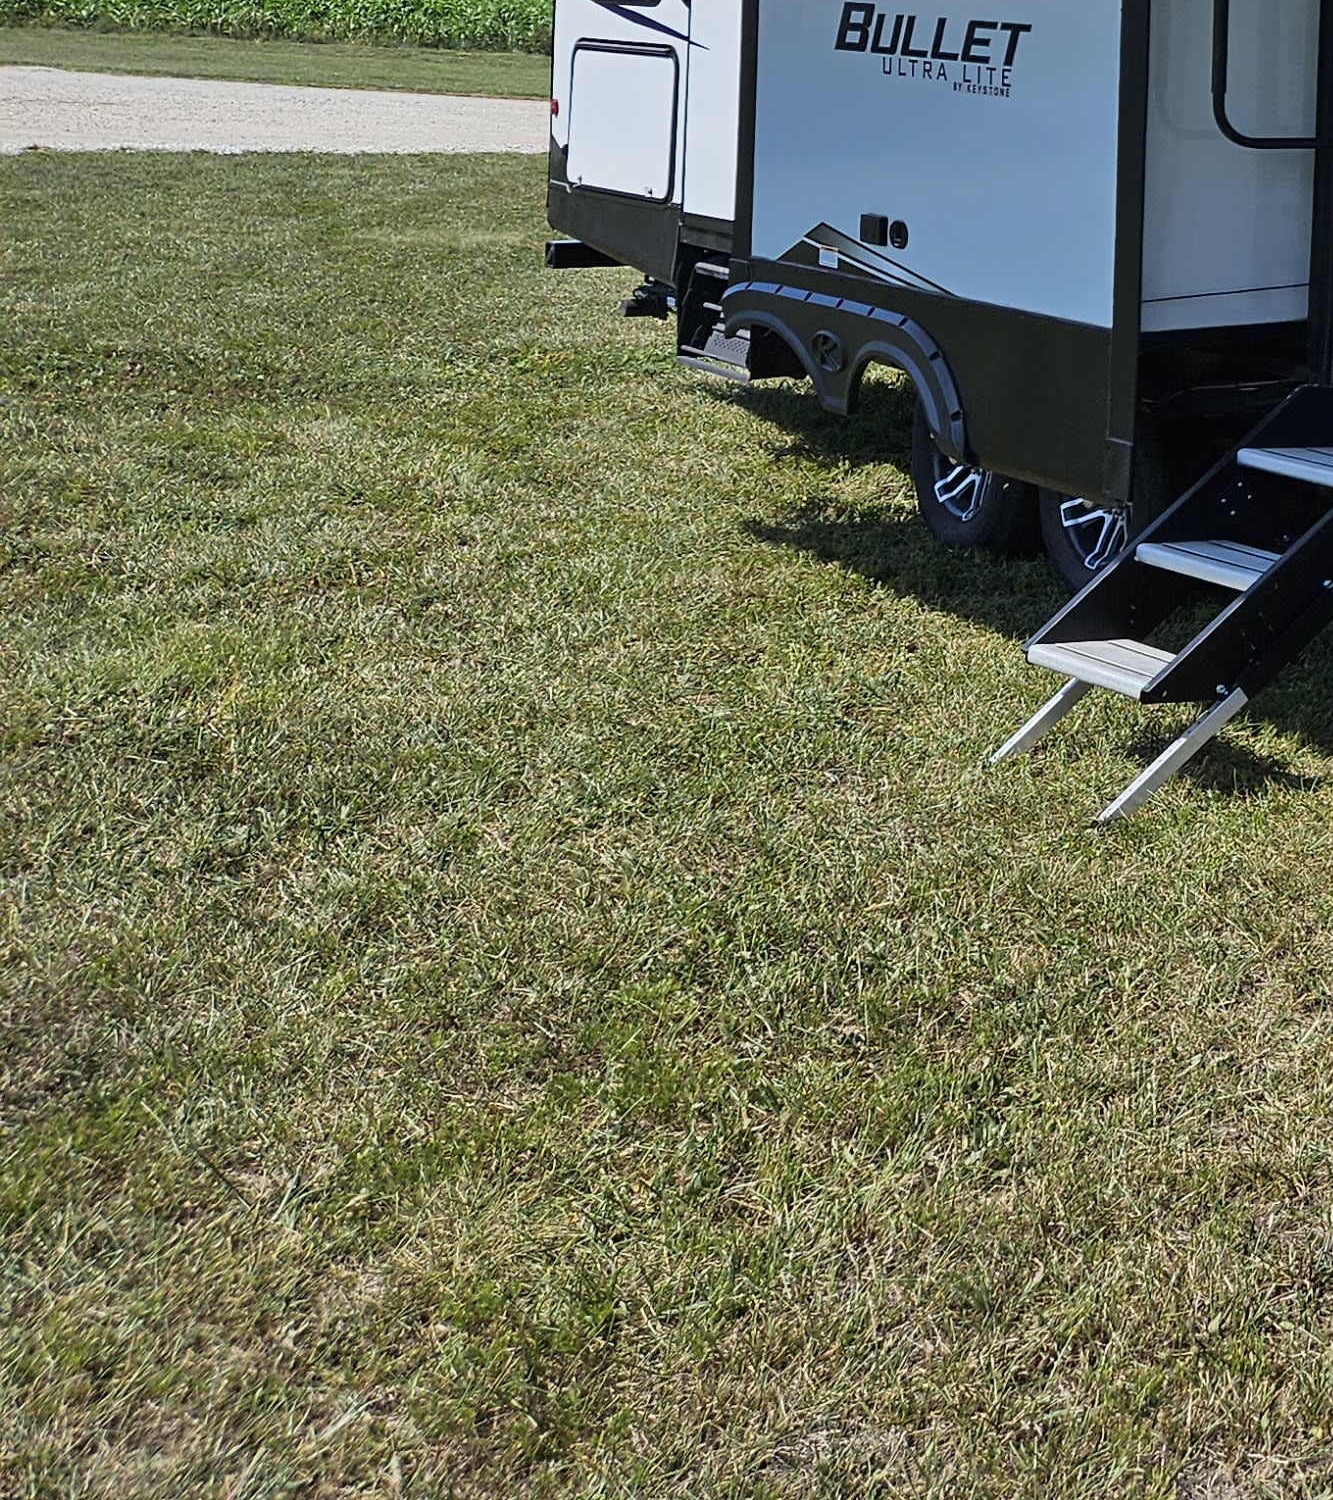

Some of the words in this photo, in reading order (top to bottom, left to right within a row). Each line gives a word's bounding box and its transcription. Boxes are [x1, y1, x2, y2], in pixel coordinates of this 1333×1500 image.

[834, 1, 1033, 68] BULLET
[882, 56, 948, 81] ULTRA
[963, 64, 1012, 88] LITE
[953, 82, 963, 92] BY
[966, 84, 1011, 98] KEYSTONE
